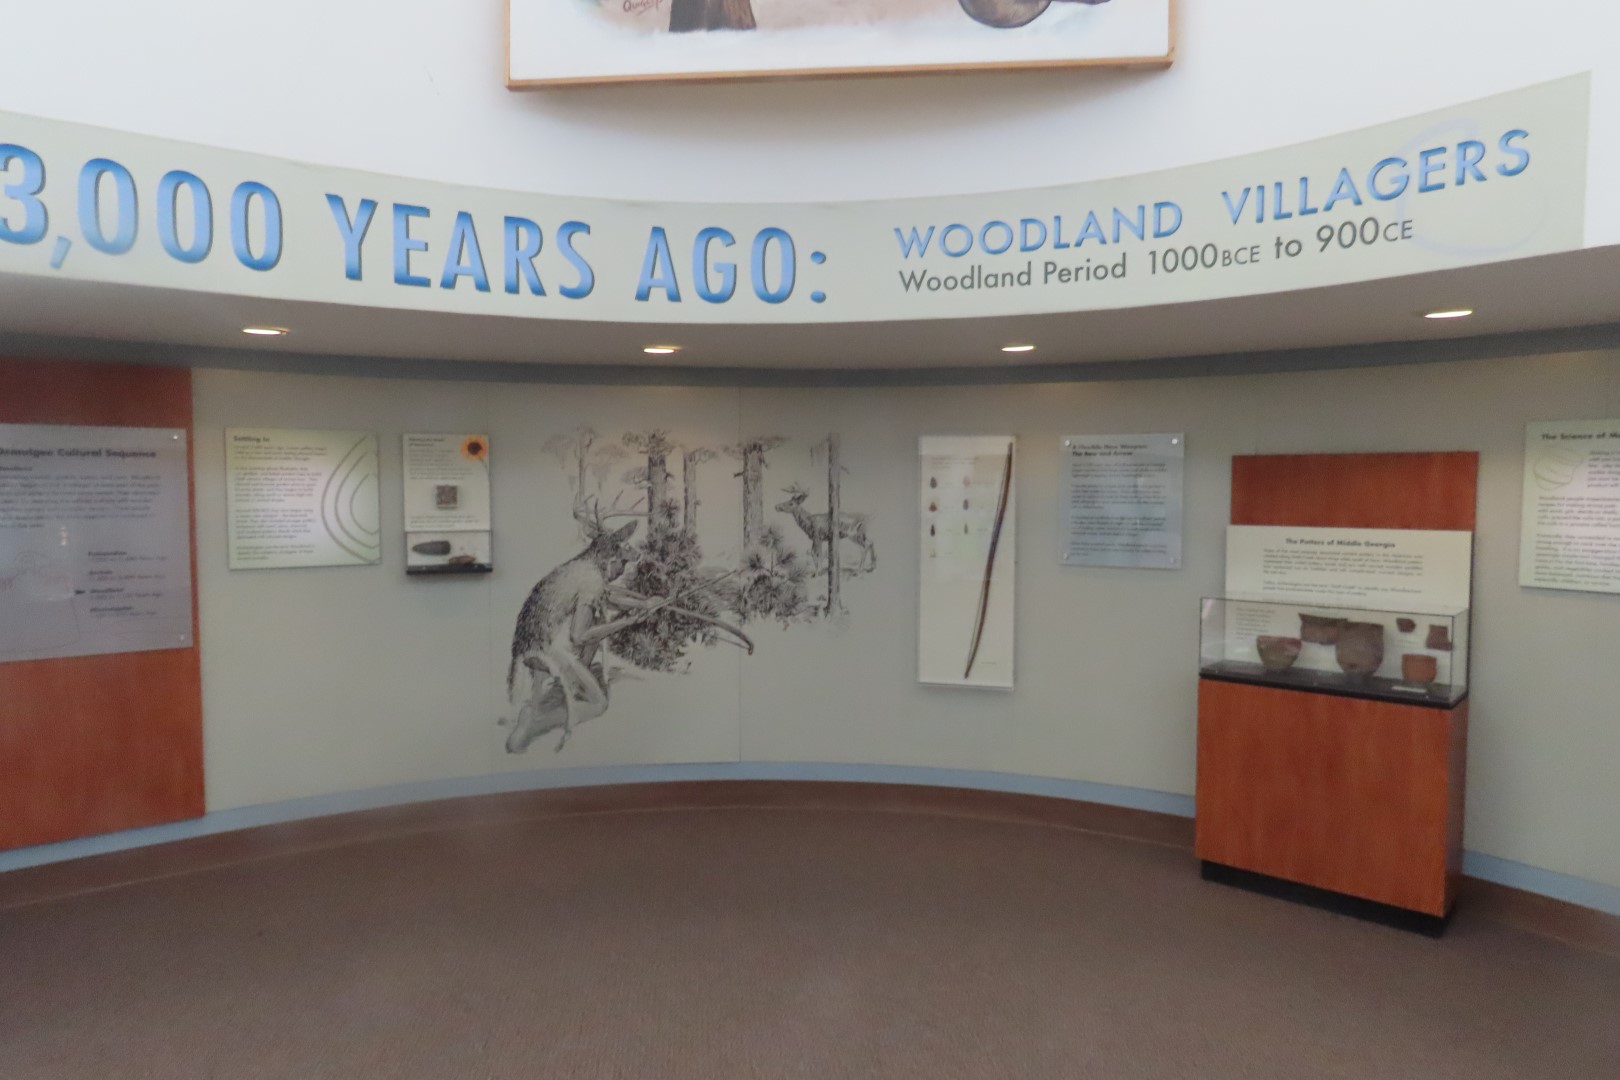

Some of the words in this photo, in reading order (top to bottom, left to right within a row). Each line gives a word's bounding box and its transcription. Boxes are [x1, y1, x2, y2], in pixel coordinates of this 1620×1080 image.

[0, 143, 283, 272] 3,000
[325, 193, 595, 300] YEARS
[634, 226, 826, 304] AGO:
[893, 201, 1183, 259] WOODLAND
[1221, 129, 1530, 225] VILLAGERS
[899, 261, 1032, 293] Woodland
[1043, 252, 1127, 284] Period
[1274, 236, 1303, 260] to
